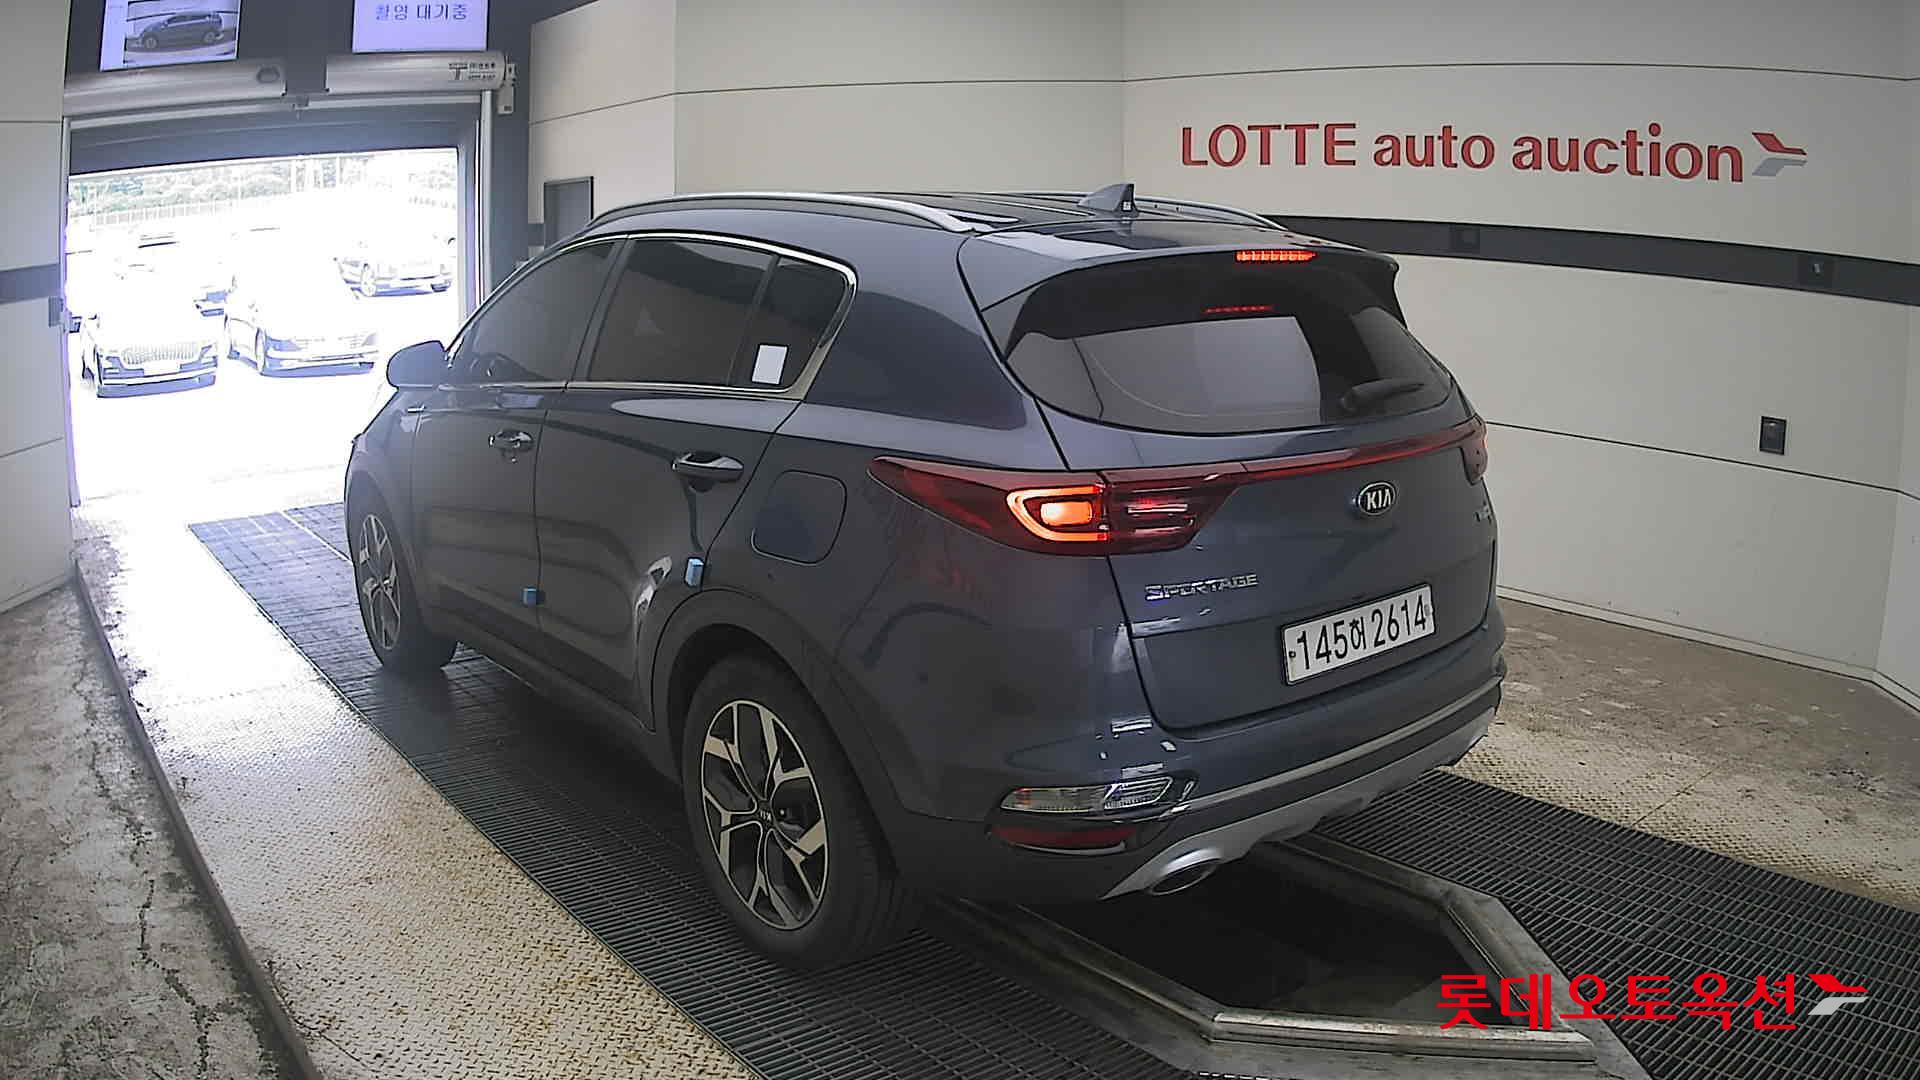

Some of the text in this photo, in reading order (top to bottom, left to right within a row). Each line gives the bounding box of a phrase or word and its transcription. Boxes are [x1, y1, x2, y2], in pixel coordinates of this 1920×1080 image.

[417, 4, 467, 21] 대기중
[1181, 122, 1744, 182] LOTTE auto auction
[1366, 488, 1392, 511] KIA
[1145, 574, 1259, 601] SPORTAGE
